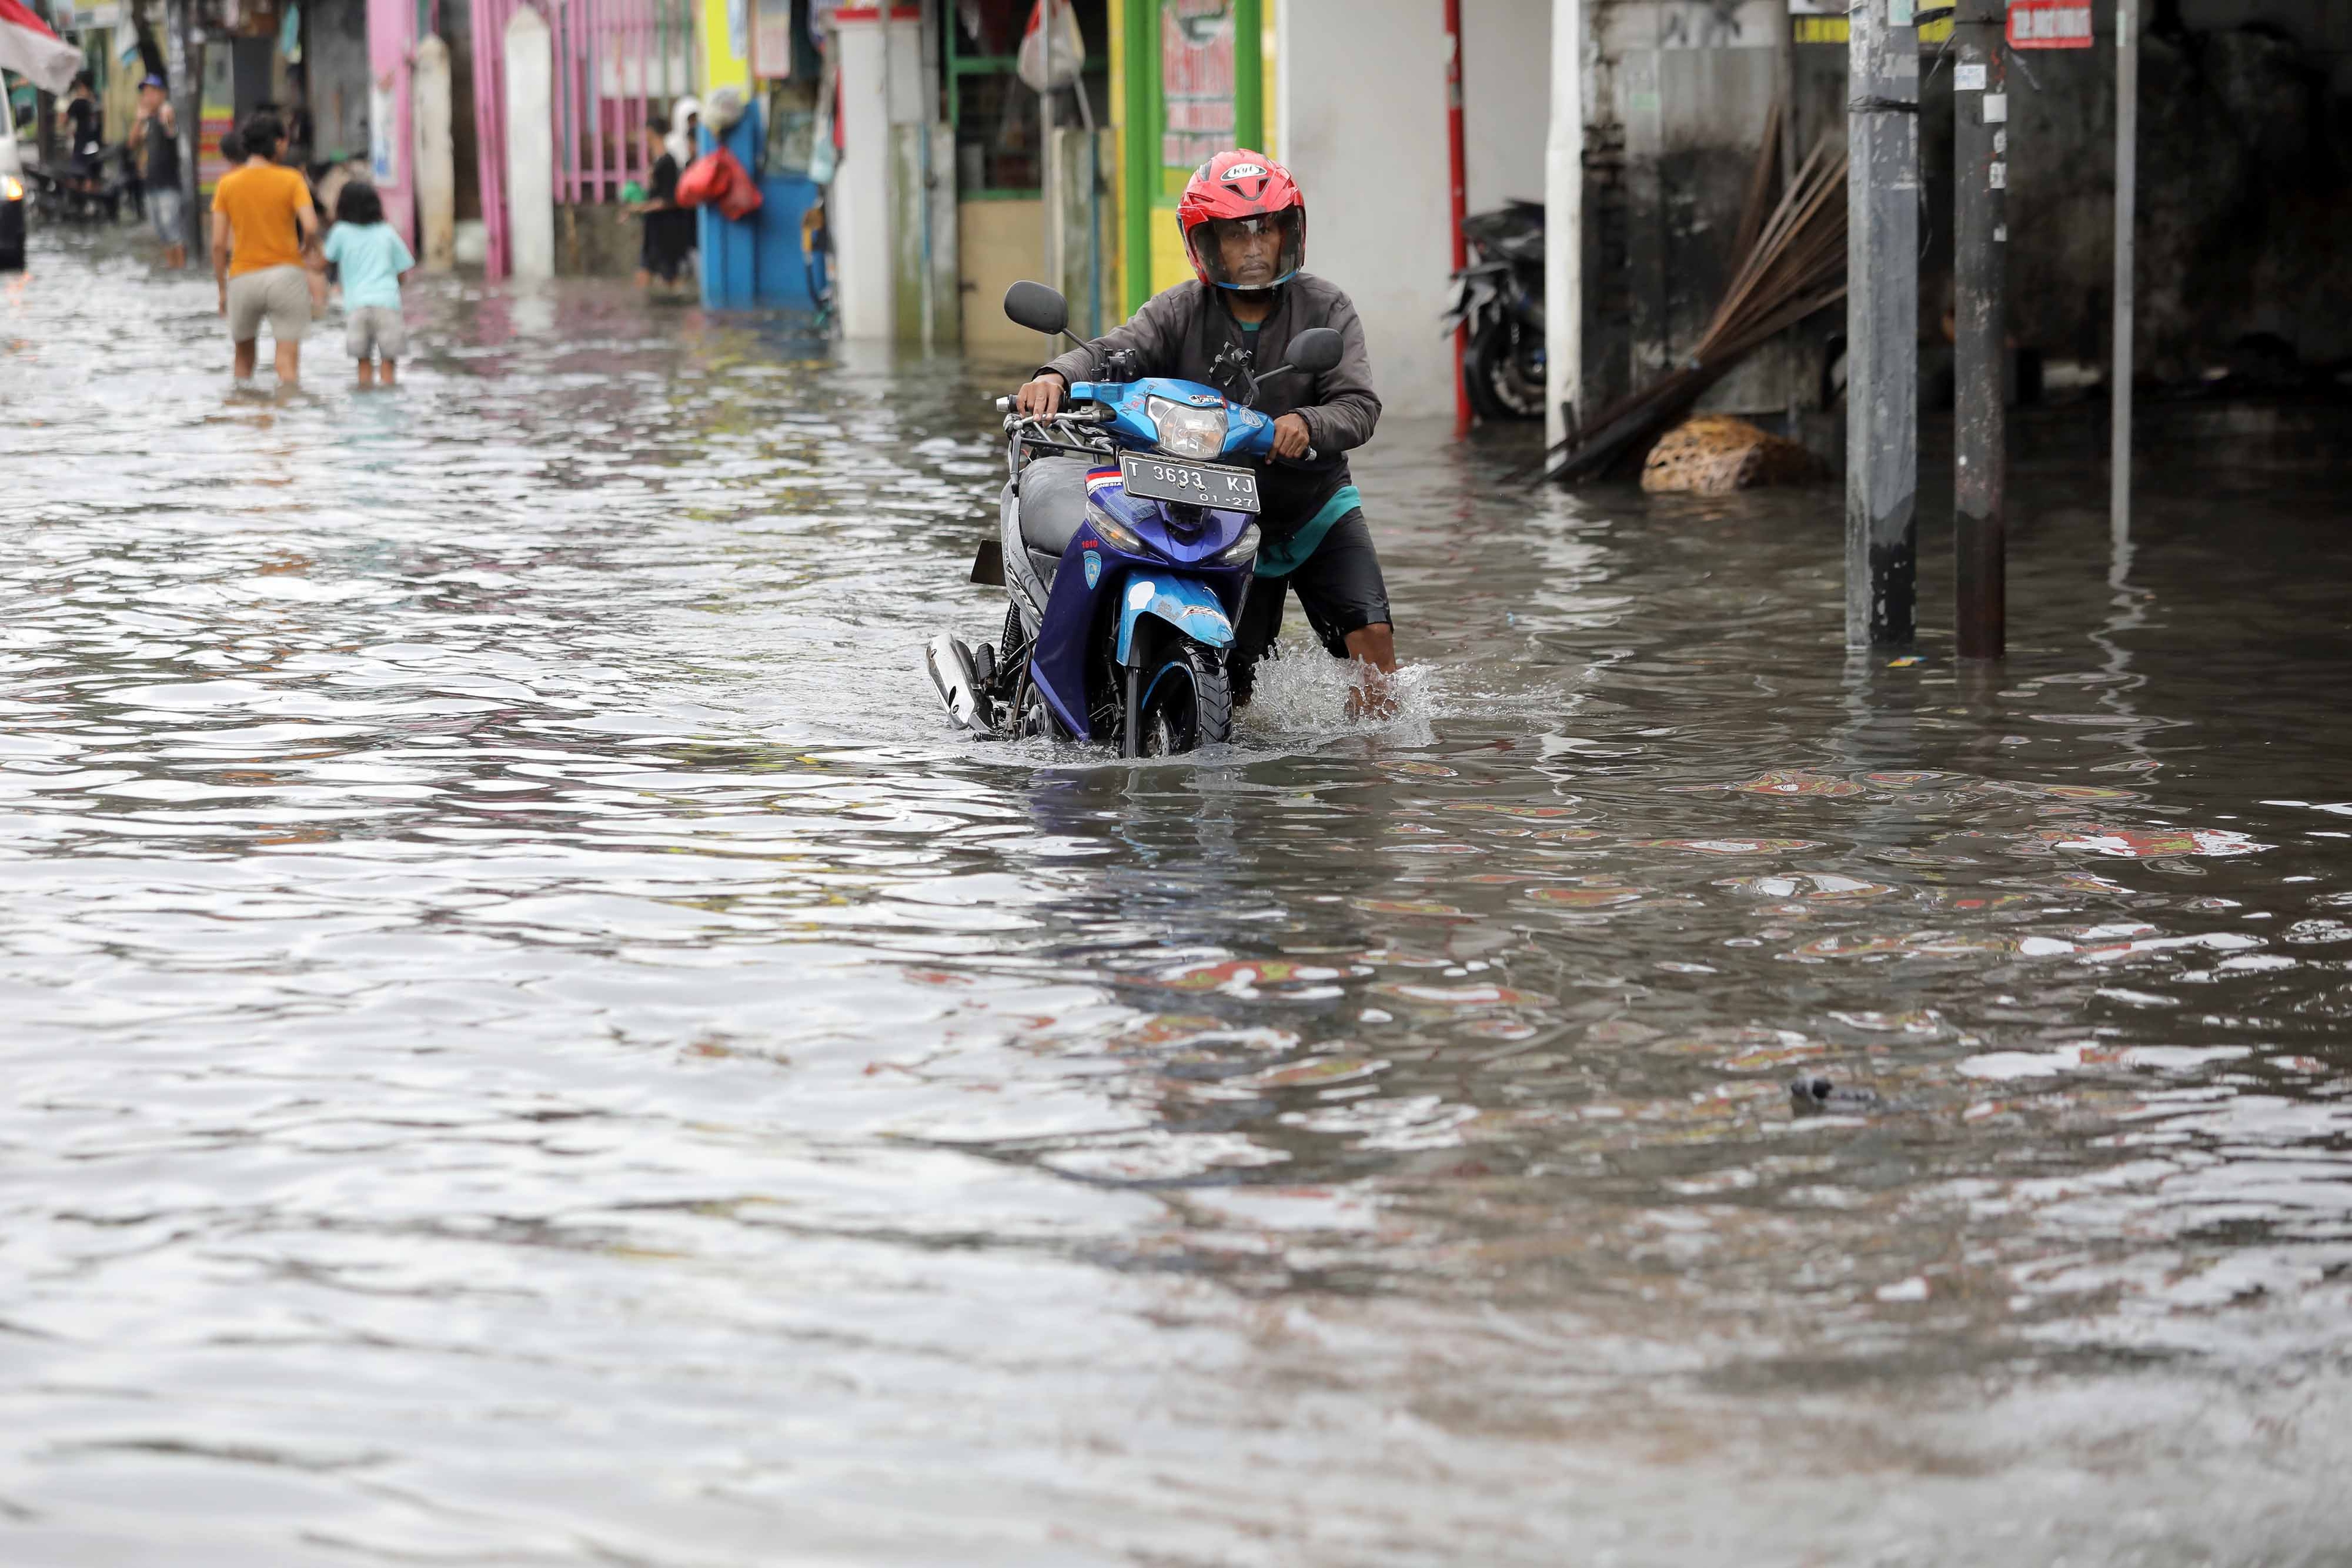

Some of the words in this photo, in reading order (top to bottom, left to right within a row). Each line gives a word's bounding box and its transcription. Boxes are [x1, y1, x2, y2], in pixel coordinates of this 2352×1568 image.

[1088, 481, 1122, 497] INDONESIA
[1128, 461, 1139, 477] T
[1153, 466, 1202, 487] 3633
[1226, 477, 1253, 493] KJ
